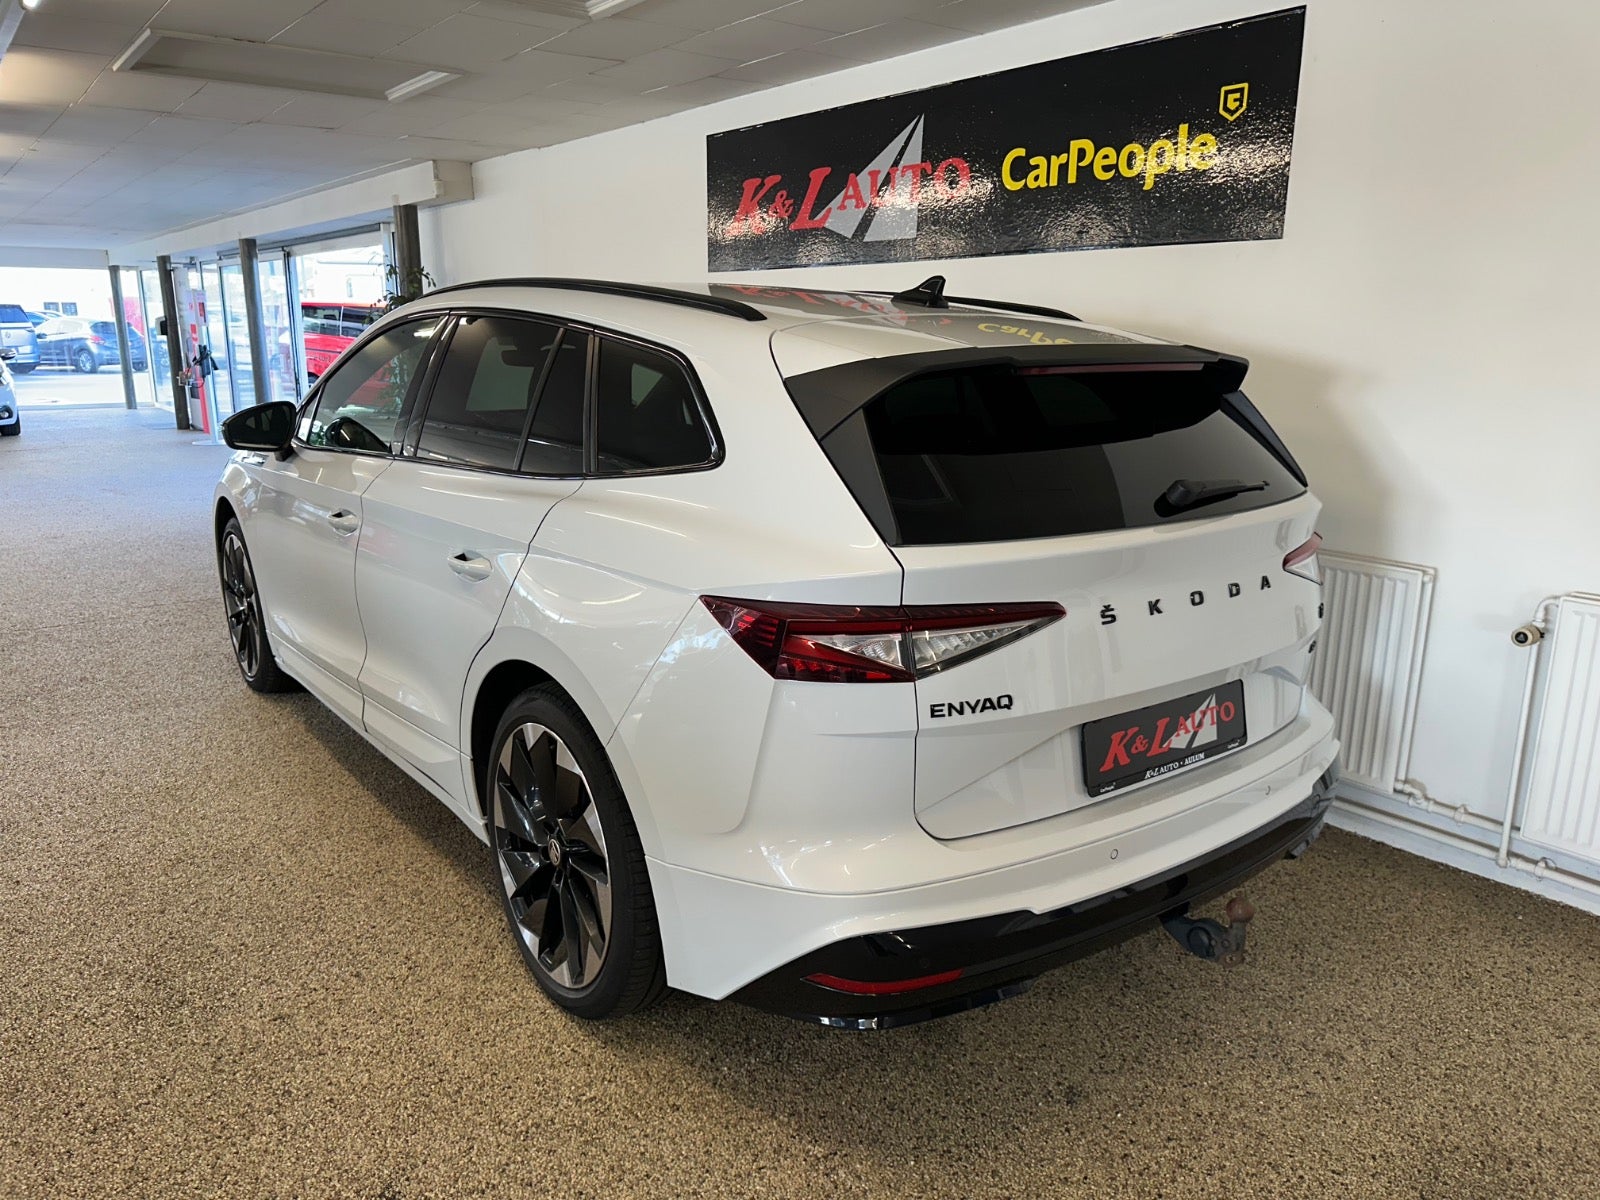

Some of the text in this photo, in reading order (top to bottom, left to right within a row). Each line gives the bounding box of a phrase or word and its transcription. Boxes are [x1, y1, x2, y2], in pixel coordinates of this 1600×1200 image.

[1001, 123, 1218, 191] CarPeople
[724, 157, 971, 238] K&L AUTO
[1100, 575, 1272, 625] ŠKODA
[930, 694, 1013, 718] ENYAQ
[1099, 701, 1236, 772] K&L AUTO
[1160, 762, 1179, 774] AUTO
[1185, 752, 1205, 765] AULUM
